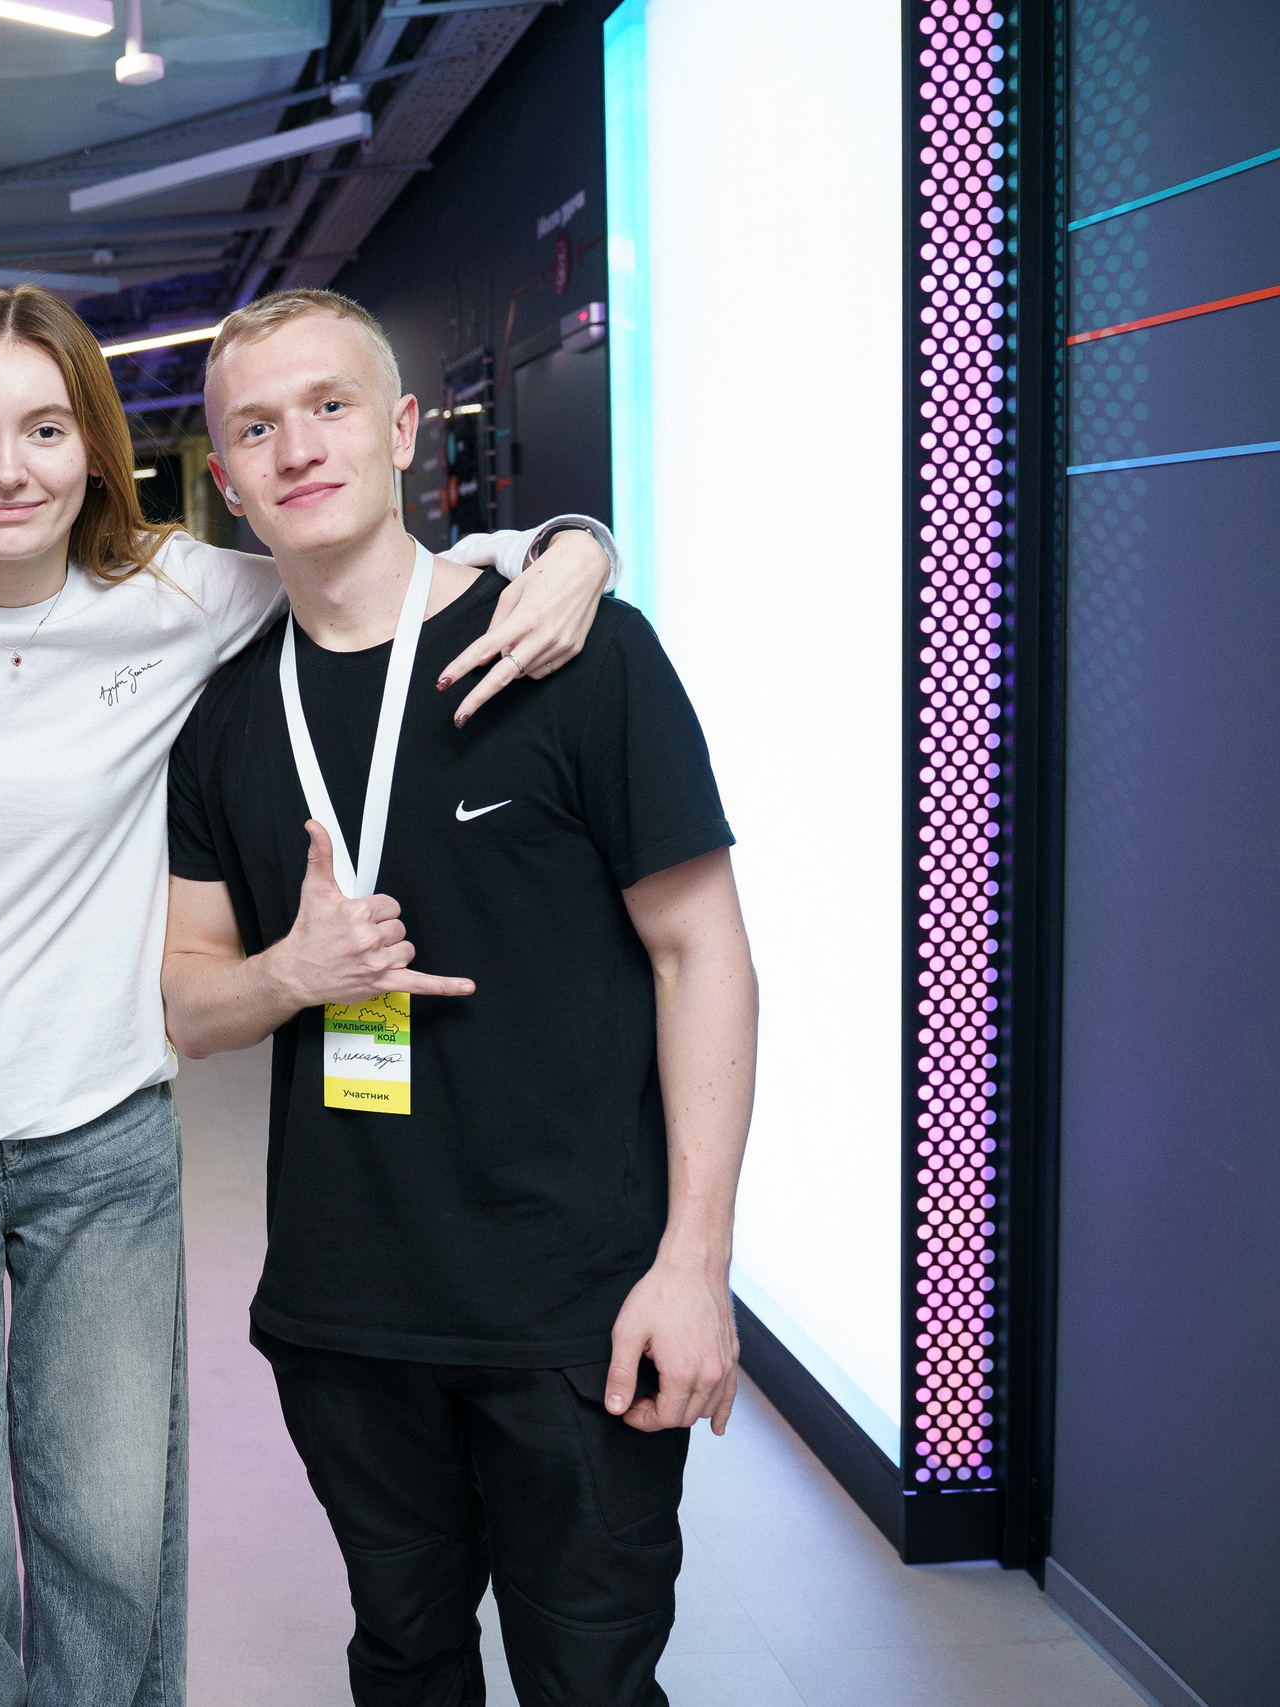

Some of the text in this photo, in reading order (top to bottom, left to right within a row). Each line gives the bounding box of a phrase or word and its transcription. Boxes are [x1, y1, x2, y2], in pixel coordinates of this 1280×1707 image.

[332, 1022, 384, 1032] УРАЛЬСКИЙ
[377, 1033, 396, 1042] КОД
[343, 1089, 390, 1100] Участник
